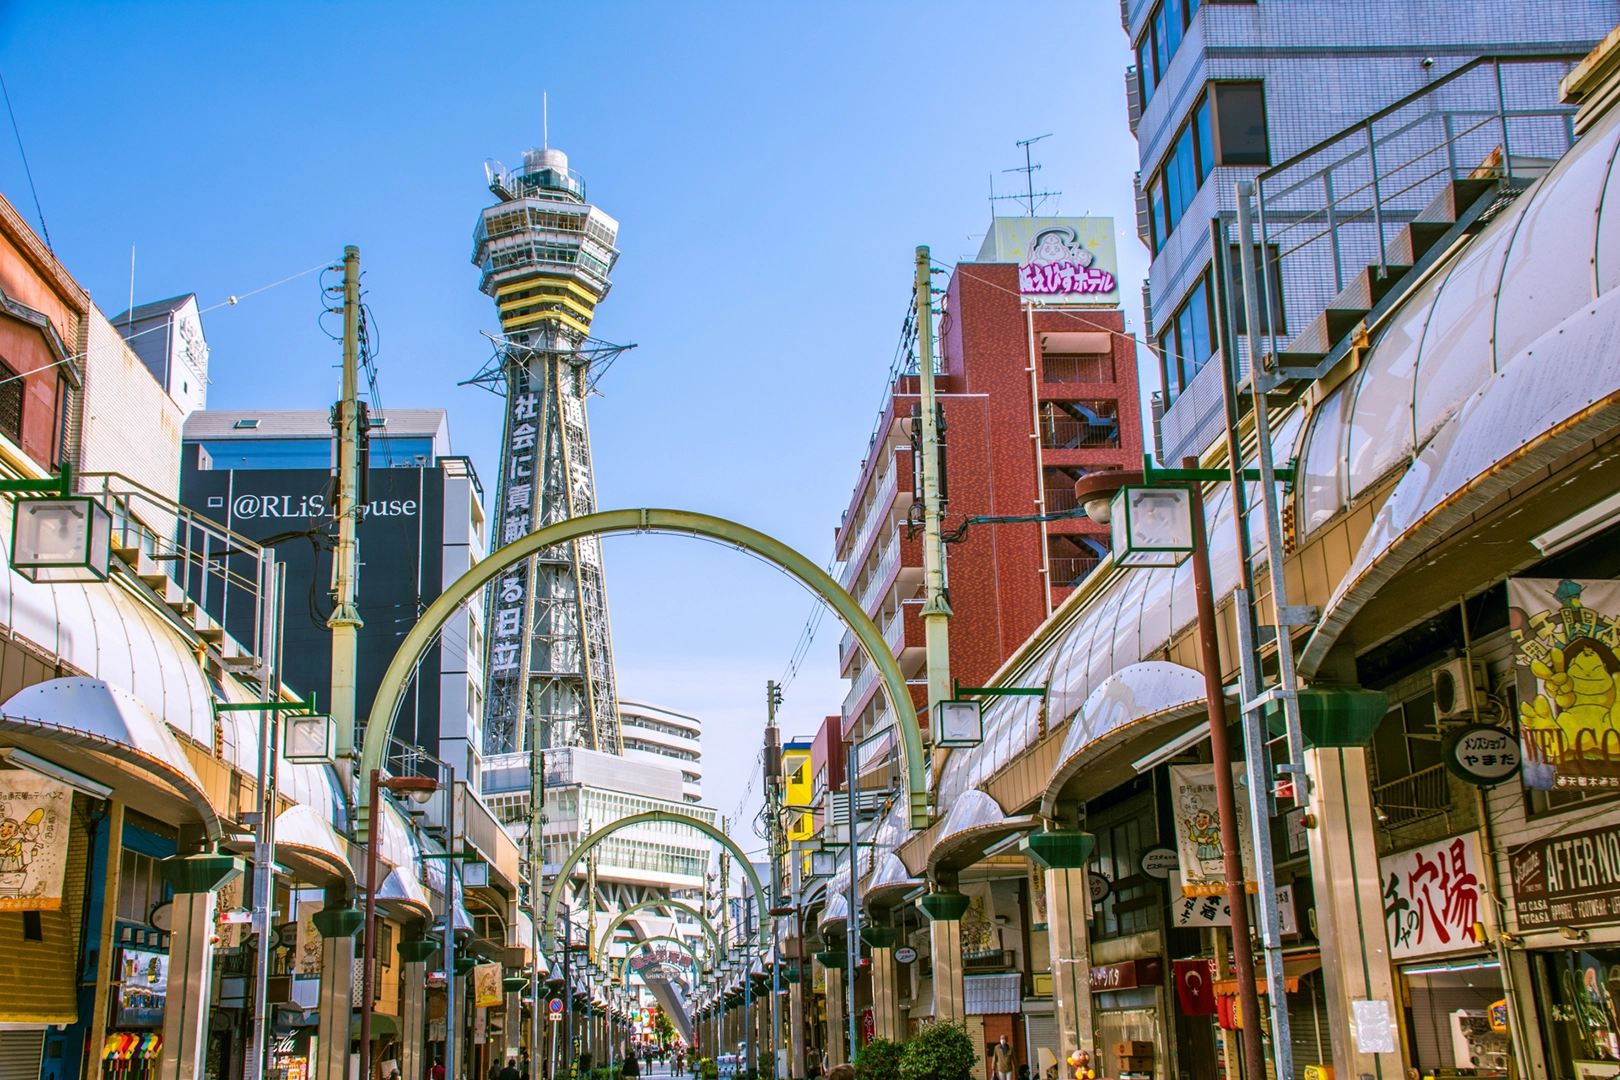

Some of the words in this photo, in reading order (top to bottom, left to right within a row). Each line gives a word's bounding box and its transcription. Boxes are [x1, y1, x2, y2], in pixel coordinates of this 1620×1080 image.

[494, 396, 538, 671] 社会に貢献る日立
[1464, 754, 1515, 766] やまだ
[1528, 899, 1548, 911] CASA
